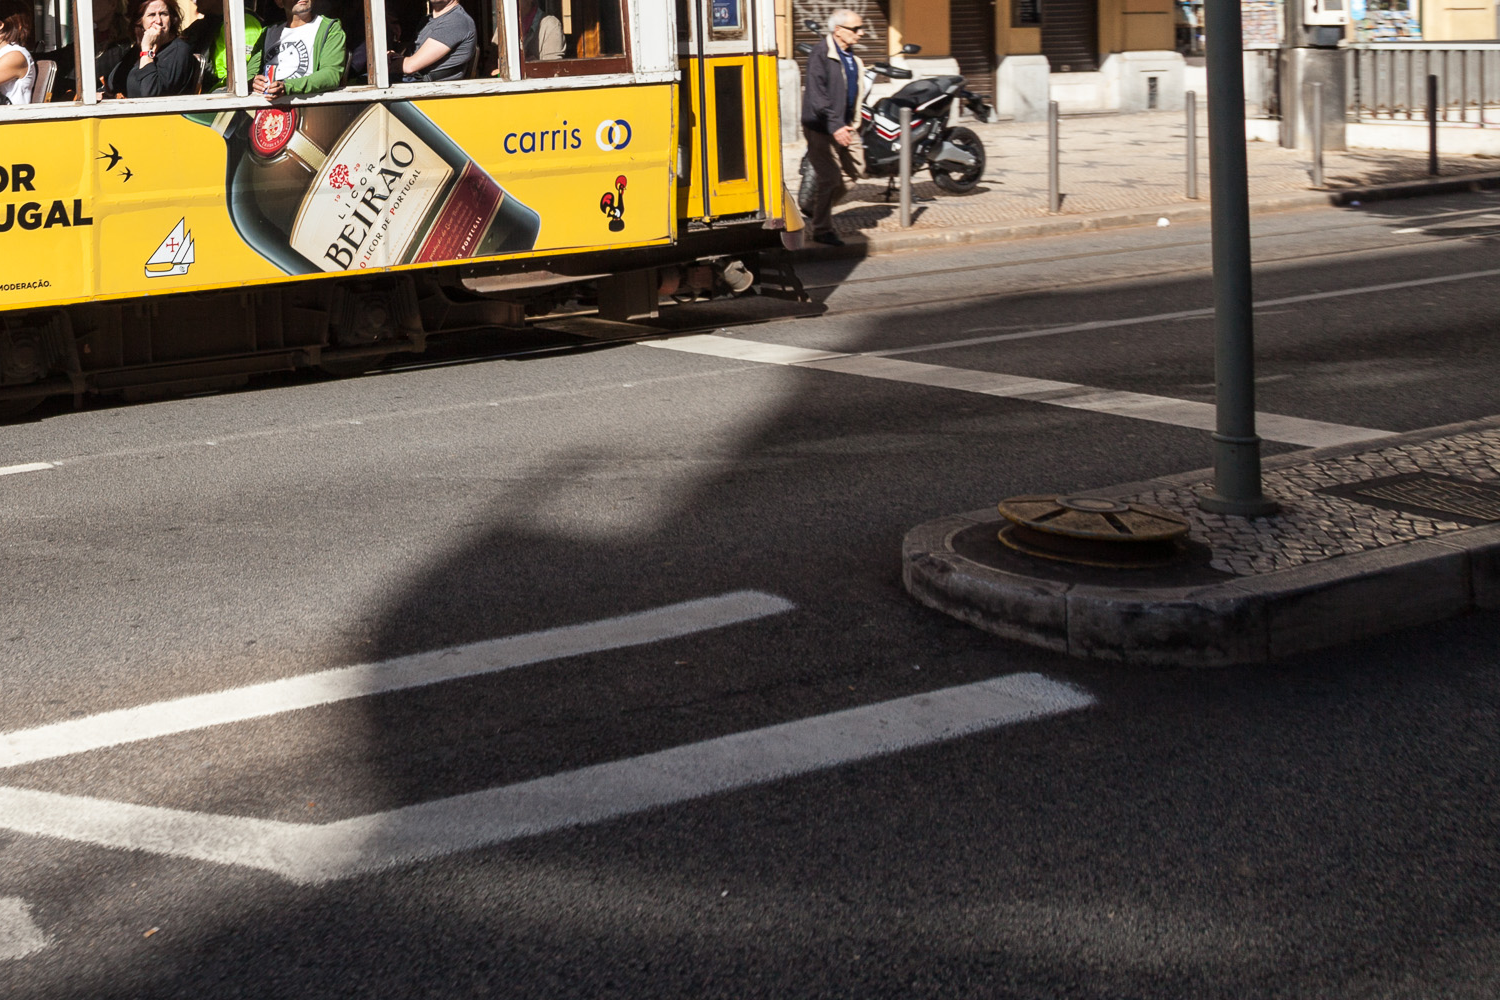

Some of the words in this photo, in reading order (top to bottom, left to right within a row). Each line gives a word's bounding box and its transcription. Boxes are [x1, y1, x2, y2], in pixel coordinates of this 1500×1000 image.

[503, 120, 582, 154] carris
[324, 140, 415, 271] BEIRÃO
[338, 163, 376, 220] LICOR
[365, 234, 384, 261] LICOR
[381, 218, 392, 231] DE
[389, 168, 422, 216] PORTUGAL
[461, 216, 482, 251] PORTUGAL
